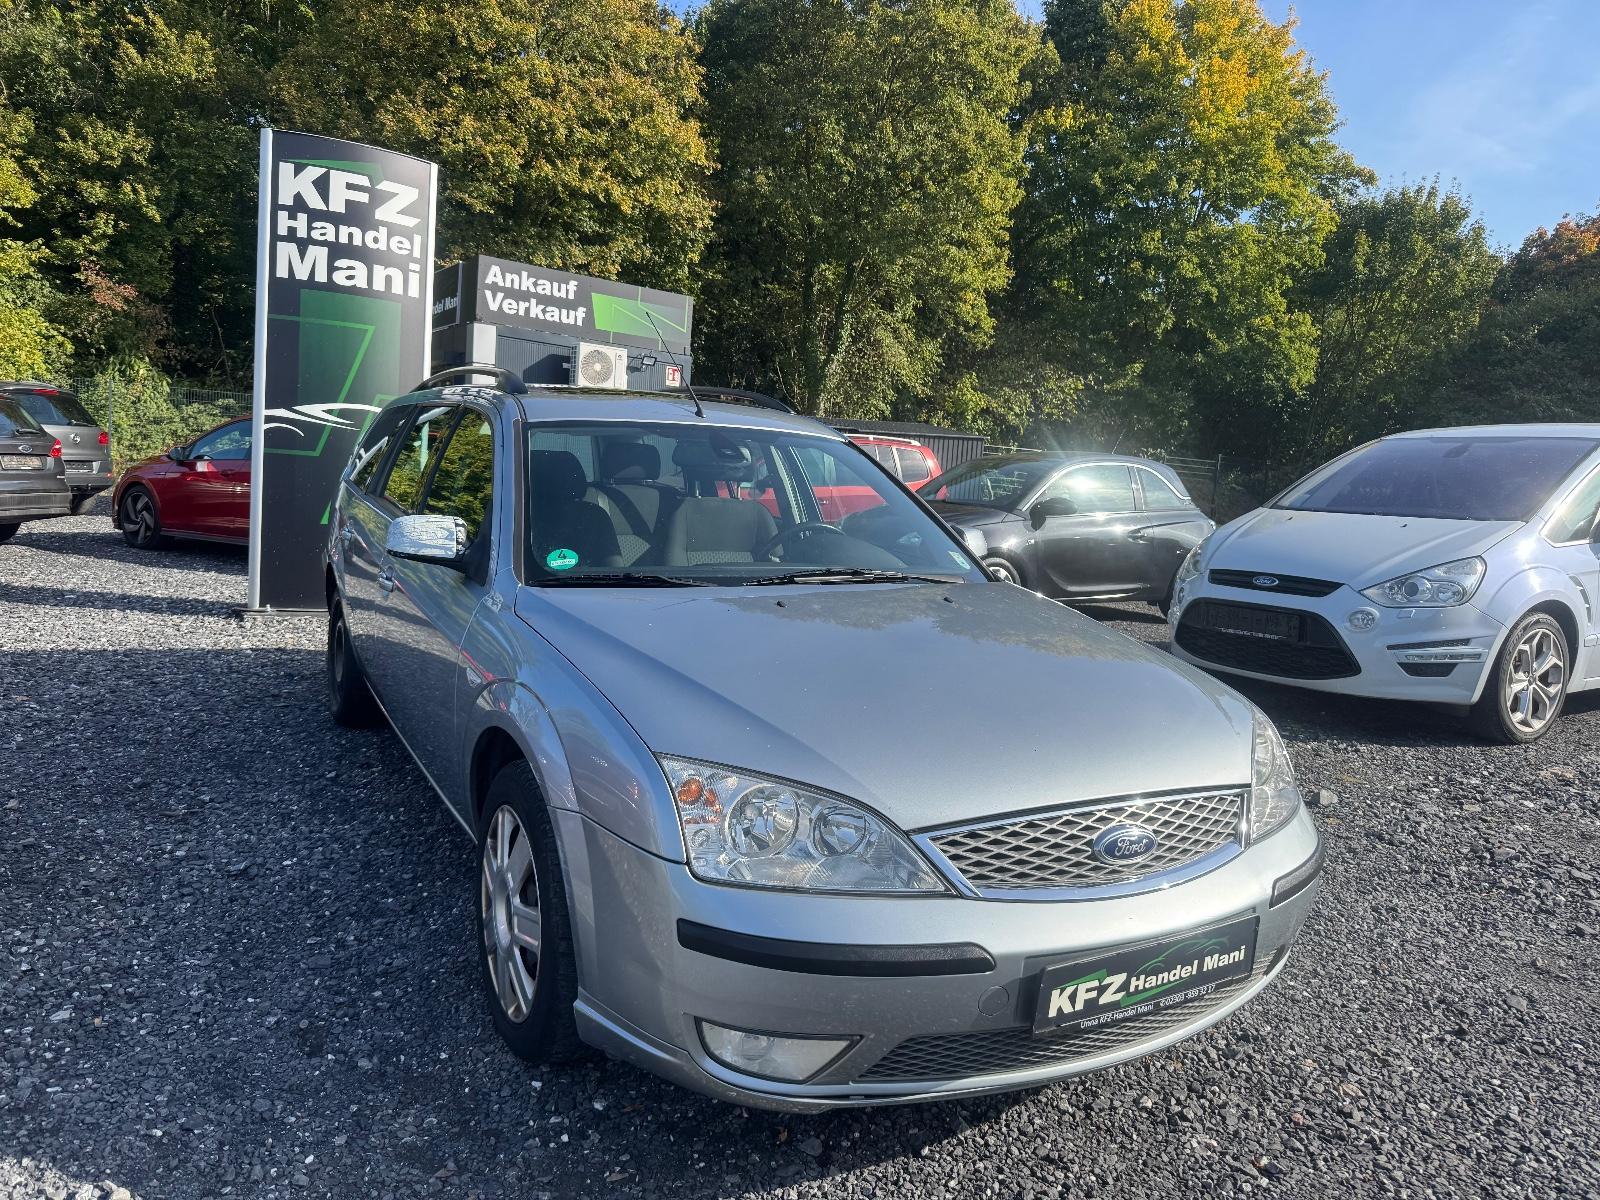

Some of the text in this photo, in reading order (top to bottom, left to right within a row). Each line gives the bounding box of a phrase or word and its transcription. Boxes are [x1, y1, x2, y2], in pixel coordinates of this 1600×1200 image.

[278, 161, 421, 228] KFZ
[277, 210, 422, 259] Handel
[275, 241, 421, 299] Mani
[484, 264, 579, 300] Ankauf
[484, 289, 587, 327] Verkauf
[558, 550, 567, 560] 4
[1115, 836, 1149, 856] Ford
[1048, 945, 1246, 1018] KFZ Handel Mani
[1080, 1017, 1099, 1029] Unna
[1099, 1007, 1137, 1023] KFZ-Handel
[1137, 1002, 1154, 1014] Mani
